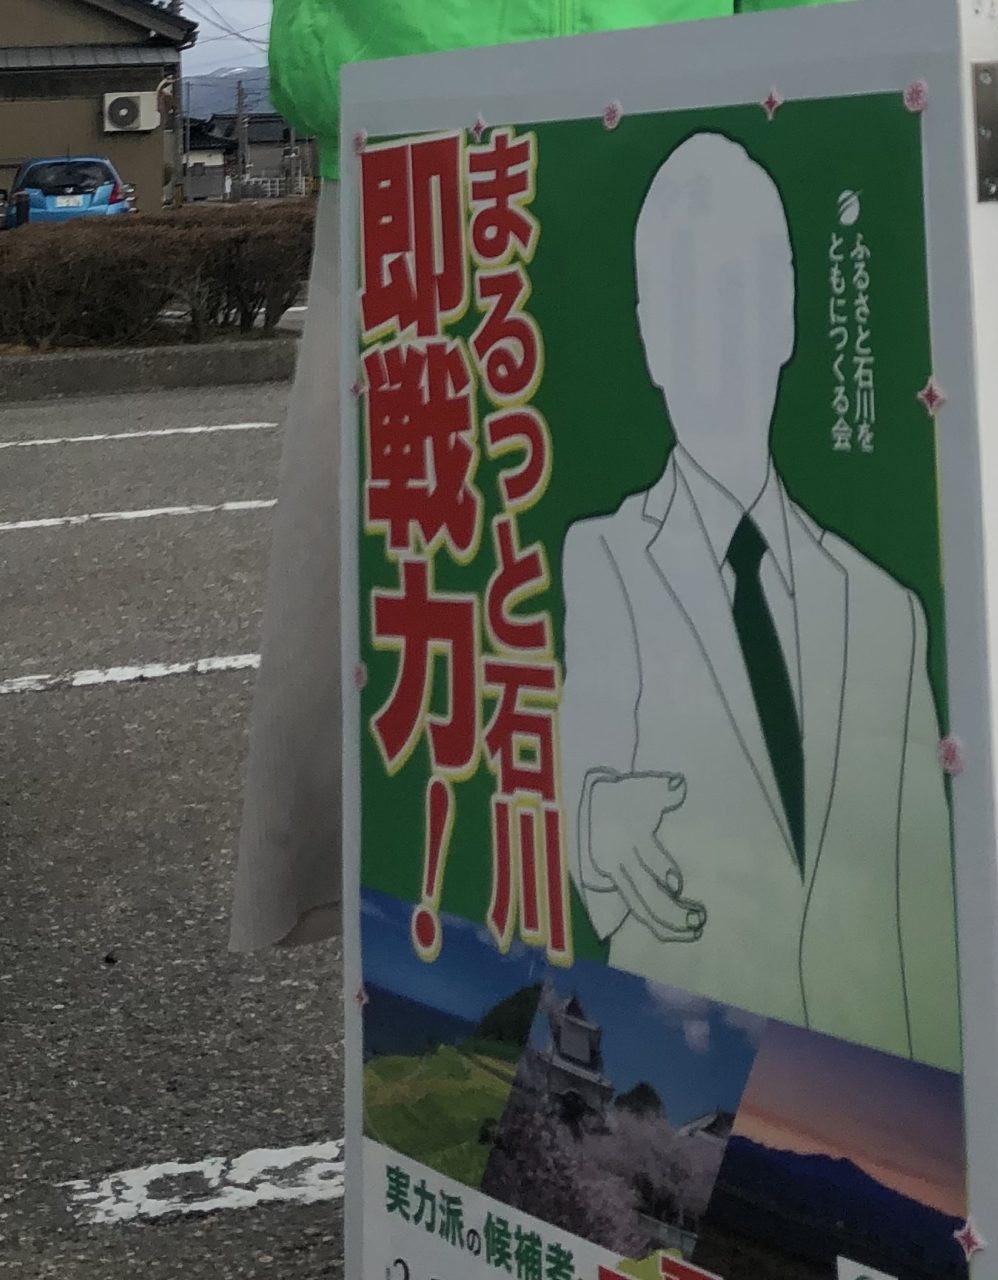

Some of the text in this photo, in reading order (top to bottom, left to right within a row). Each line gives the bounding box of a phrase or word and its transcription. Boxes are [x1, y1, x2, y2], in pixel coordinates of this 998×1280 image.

[360, 130, 481, 961] 即戦力！
[469, 127, 574, 967] まるっと石川
[829, 232, 853, 452] ともにつくる会
[850, 232, 875, 453] ふるさと石川を
